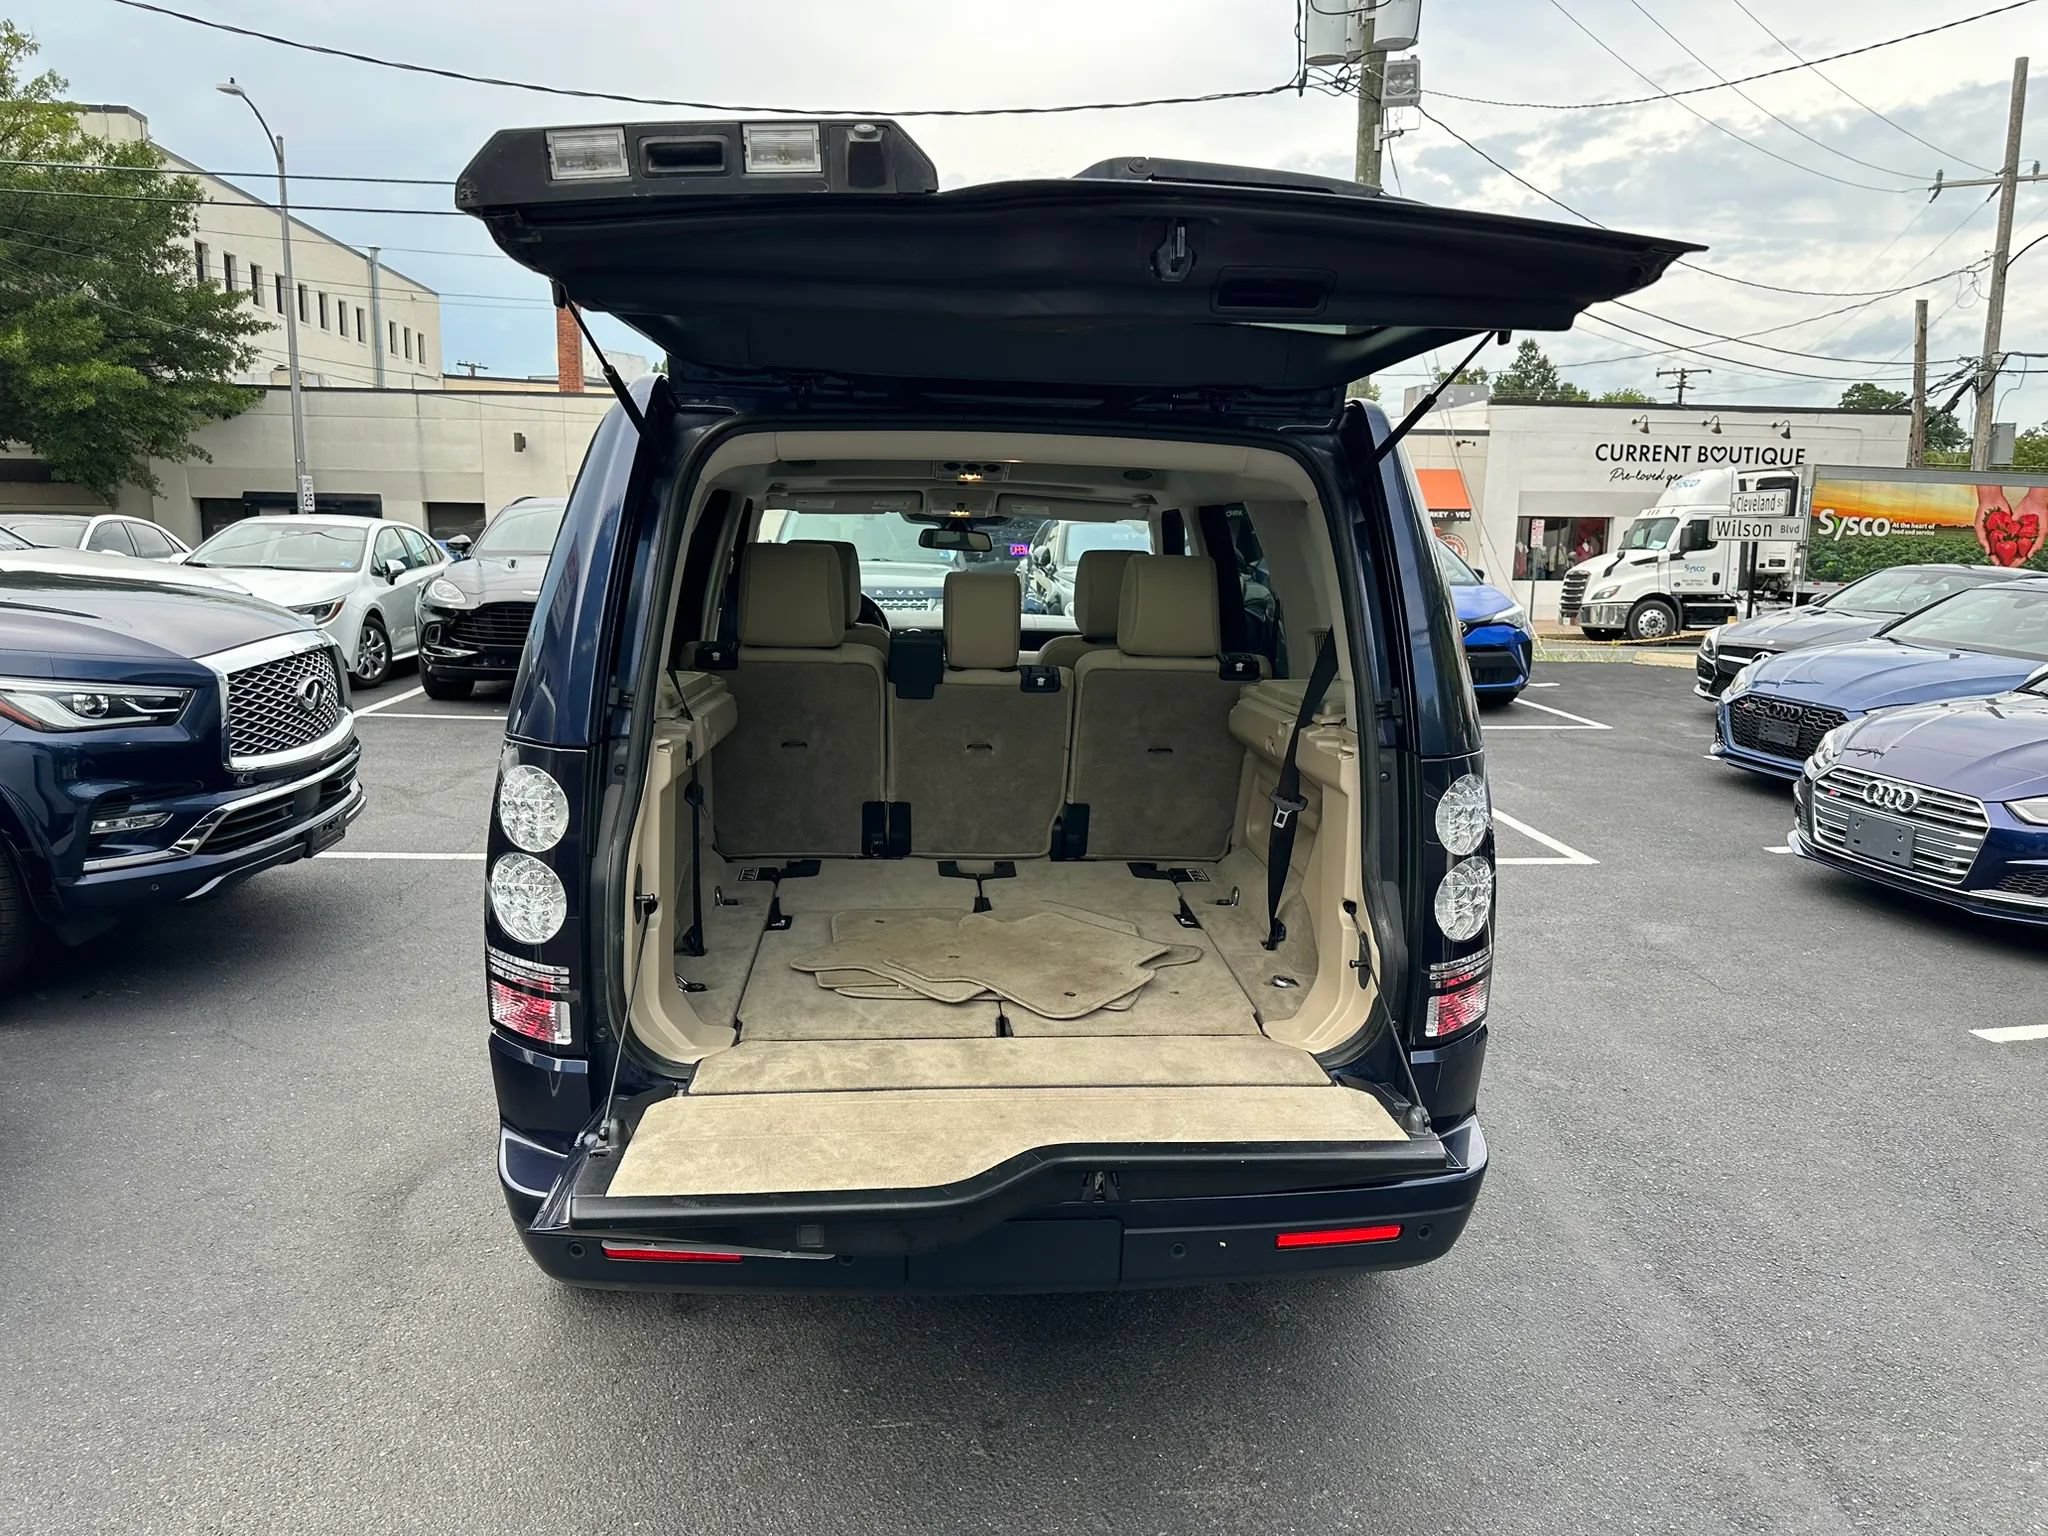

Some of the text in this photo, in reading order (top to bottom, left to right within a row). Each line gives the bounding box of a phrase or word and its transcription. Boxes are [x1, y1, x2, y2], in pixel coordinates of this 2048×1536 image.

[1595, 443, 1692, 462] CURRENT
[1608, 466, 1665, 482] Pre-loved
[304, 493, 313, 507] 25
[1736, 494, 1776, 512] Cleveland
[1716, 519, 1800, 537] Wilson Blvd
[1900, 521, 1910, 529] the
[1009, 544, 1028, 556] OPEN
